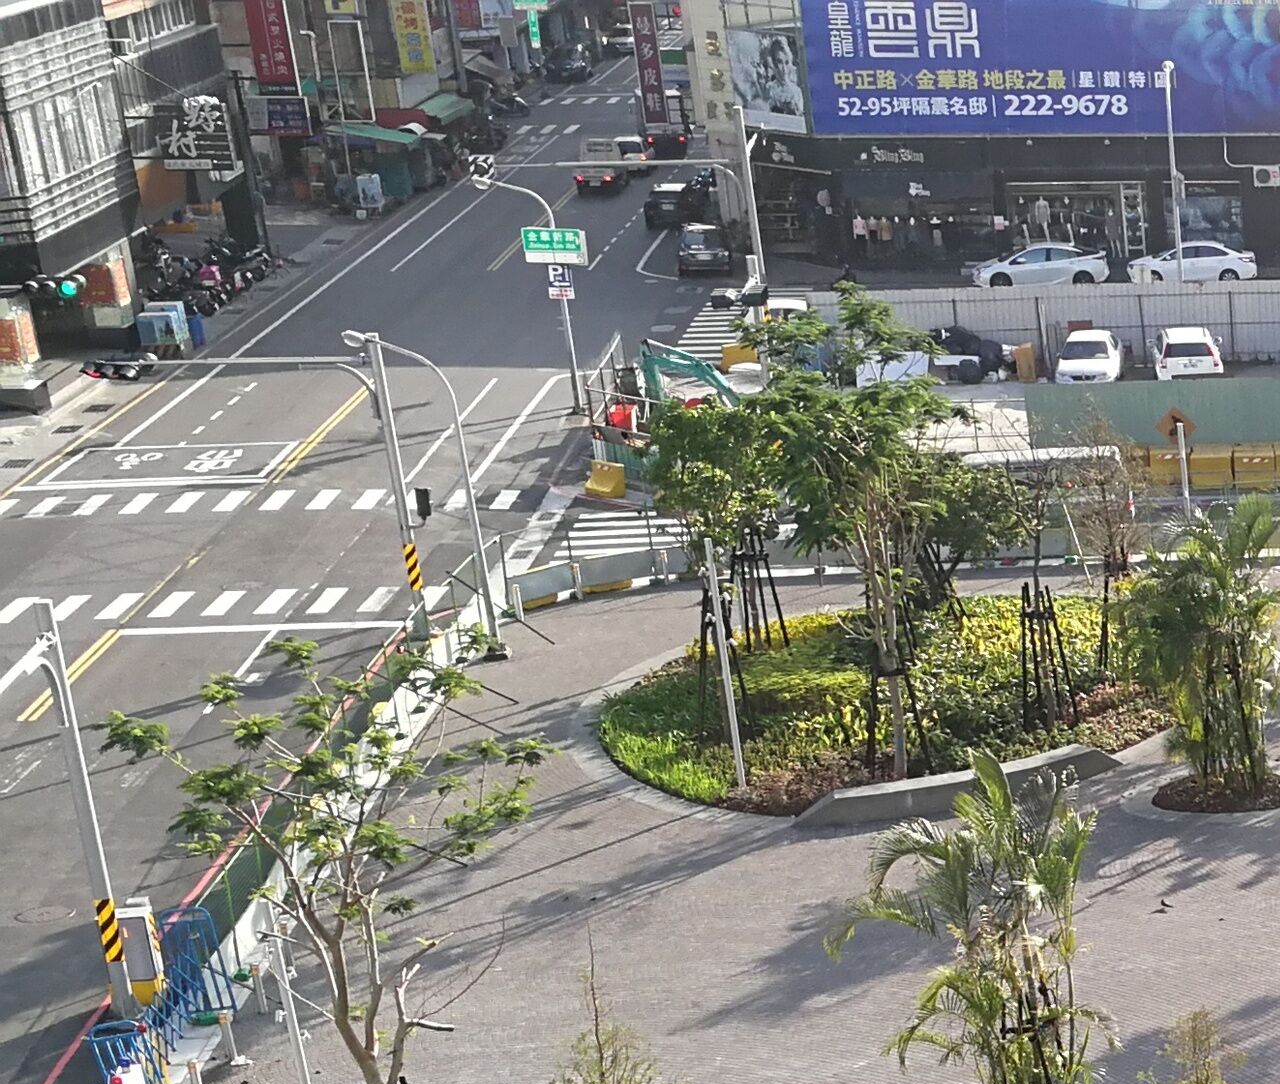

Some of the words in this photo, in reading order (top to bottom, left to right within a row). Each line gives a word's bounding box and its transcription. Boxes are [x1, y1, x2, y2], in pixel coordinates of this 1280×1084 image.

[636, 16, 663, 112] 曼多皮鞋
[983, 69, 1066, 91] 地段之最
[1004, 94, 1128, 116] 222-9678
